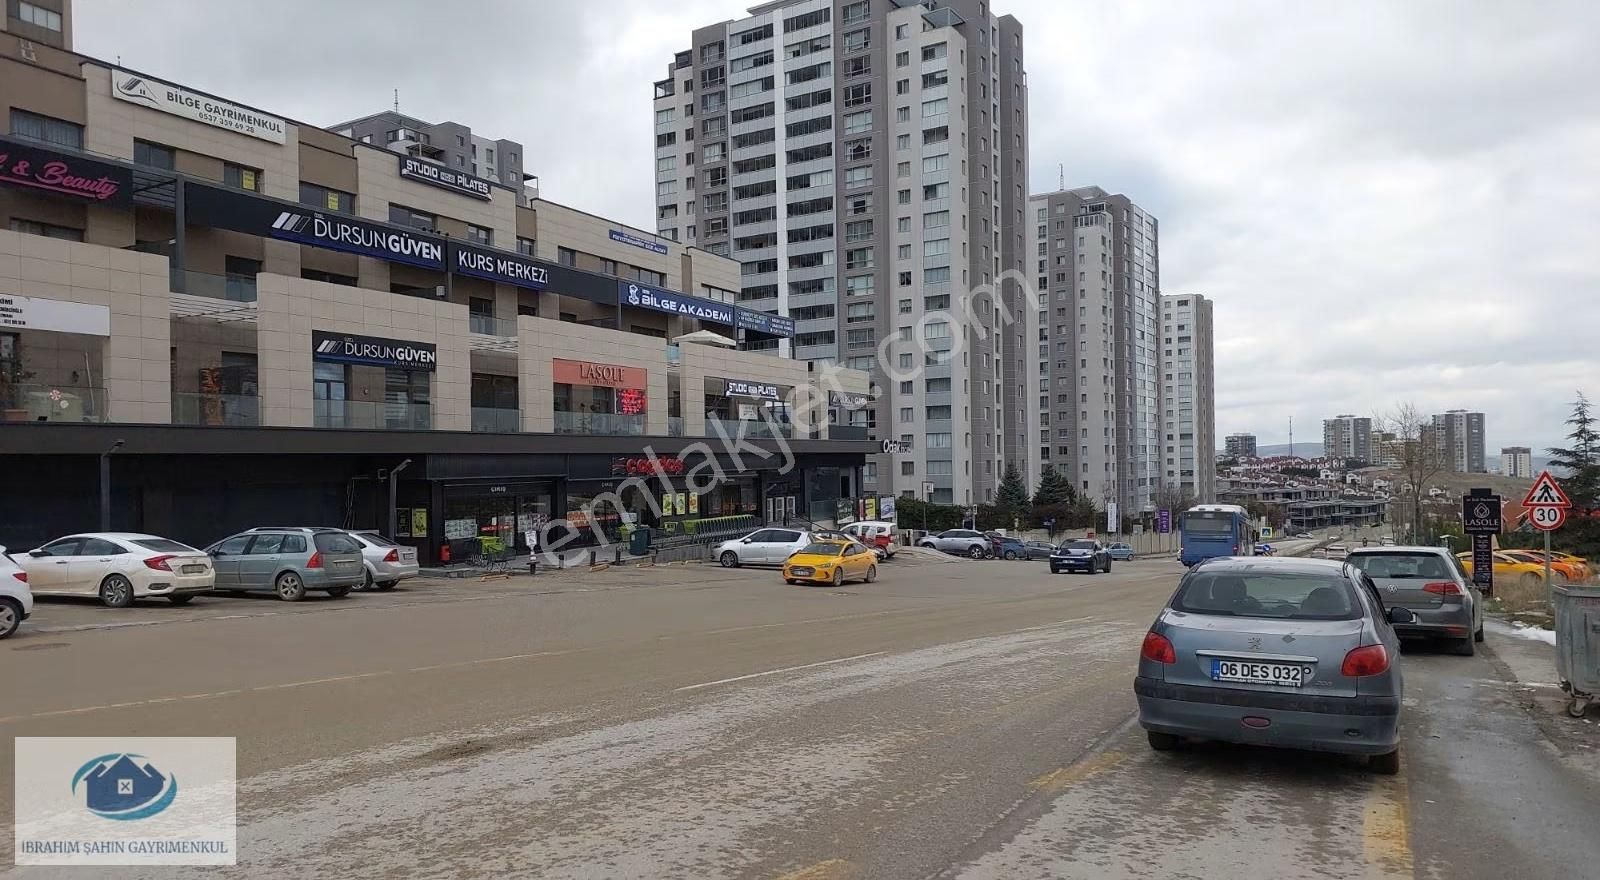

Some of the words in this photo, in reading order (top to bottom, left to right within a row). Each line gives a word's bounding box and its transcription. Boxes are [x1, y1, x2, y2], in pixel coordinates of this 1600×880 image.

[167, 90, 200, 110] BİLGE
[204, 103, 282, 133] GAYRİMENKUL
[199, 113, 217, 122] 0537
[220, 117, 233, 126] 359
[235, 121, 244, 130] 69
[11, 160, 30, 176] &
[35, 161, 120, 199] Beauty
[406, 160, 438, 178] STUDIO
[457, 174, 489, 193] PİLATES
[458, 250, 494, 272] KURS
[641, 293, 677, 311] BİLGE
[678, 304, 732, 322] AKADEMİ
[728, 382, 747, 393] STUDIO
[1536, 508, 1558, 522] 30
[1220, 663, 1238, 677] 06
[1241, 664, 1270, 679] DES
[1272, 666, 1300, 681] 032
